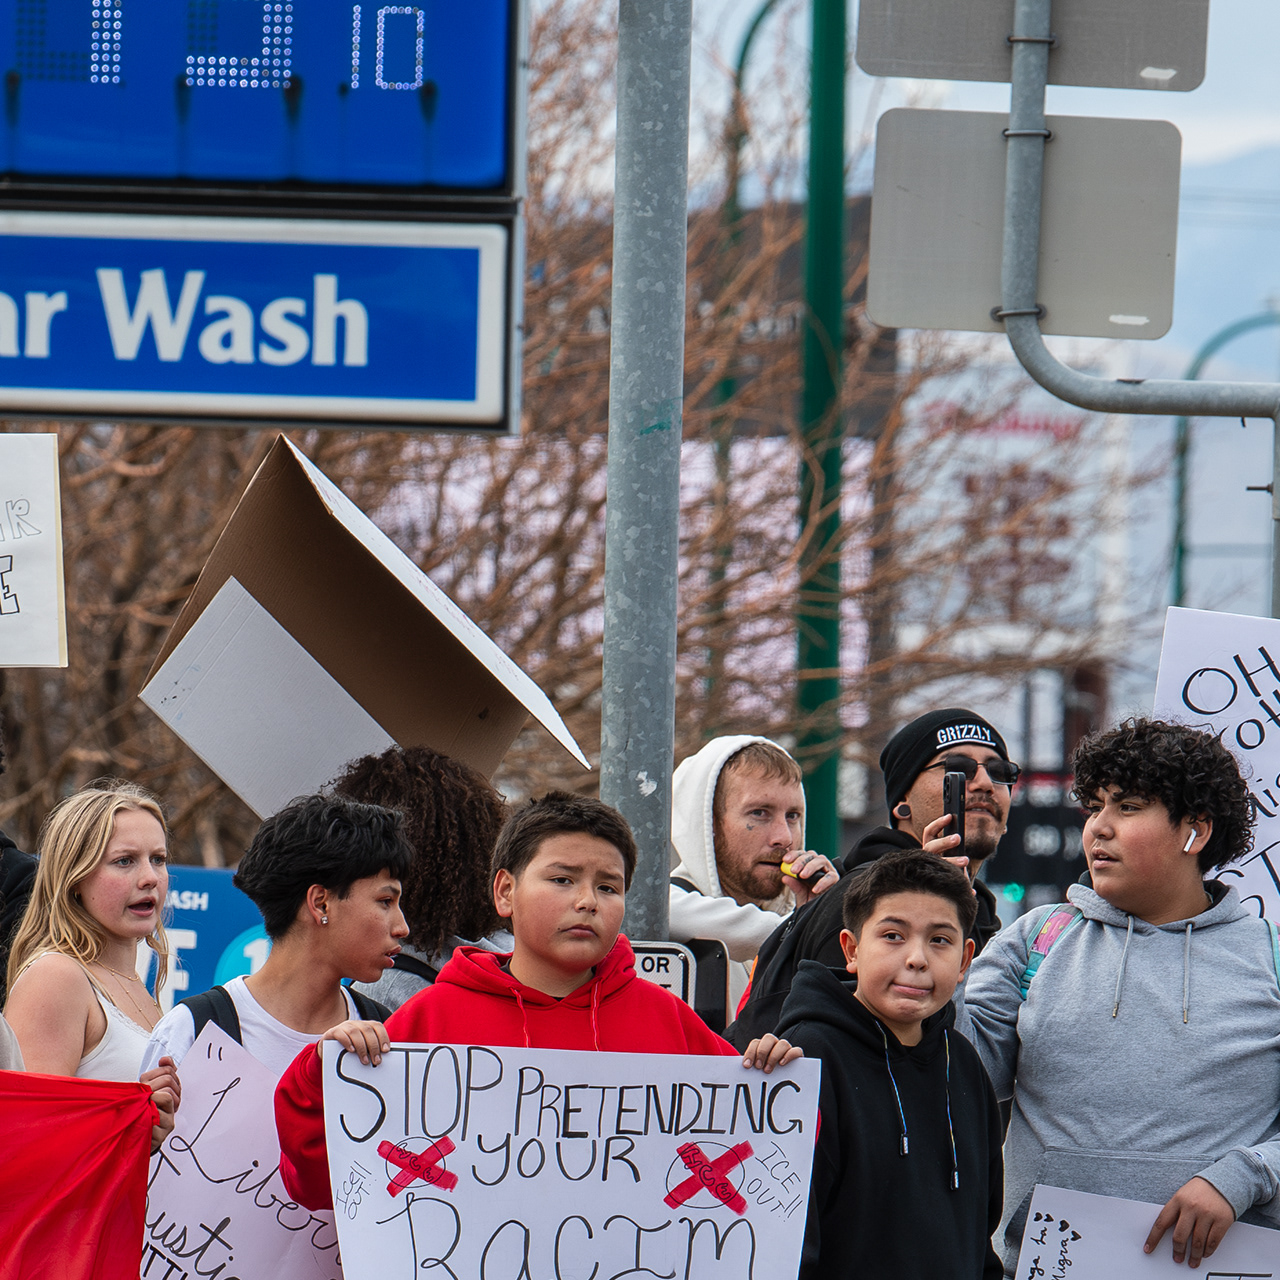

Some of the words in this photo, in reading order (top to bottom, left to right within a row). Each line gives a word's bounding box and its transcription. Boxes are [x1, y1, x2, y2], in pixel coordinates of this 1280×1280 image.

[96, 268, 369, 367] Wash
[167, 890, 209, 911] ASH
[641, 955, 670, 973] OR
[335, 1045, 503, 1142] STOP
[514, 1066, 804, 1139] PRETENDING
[681, 1148, 732, 1201] ICE
